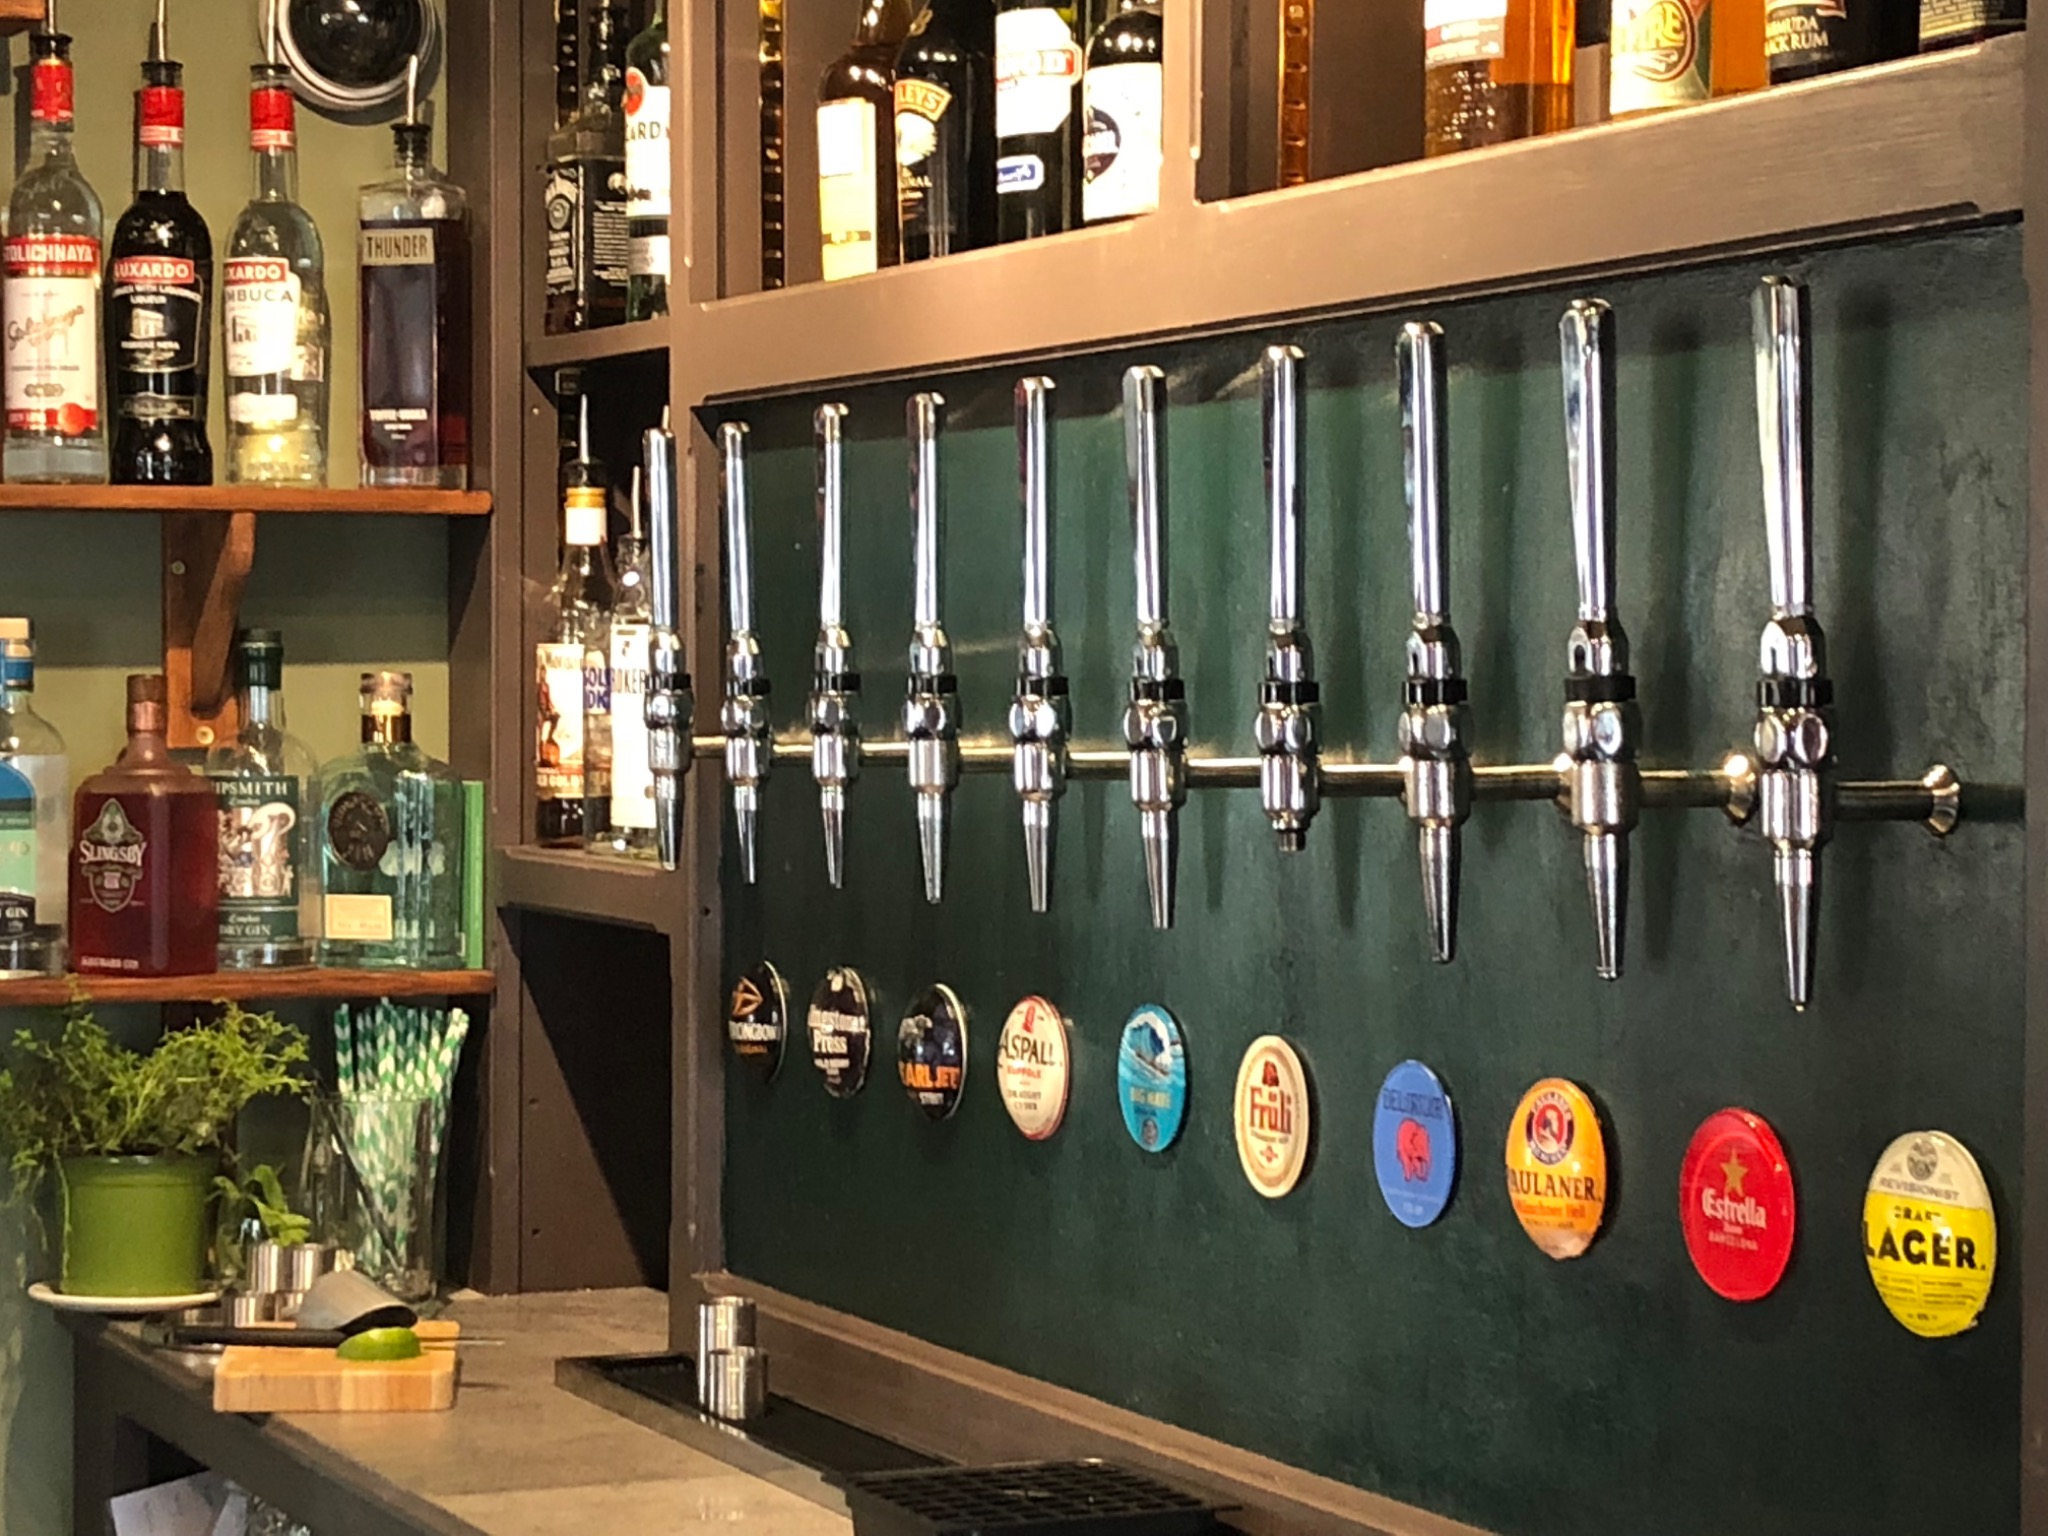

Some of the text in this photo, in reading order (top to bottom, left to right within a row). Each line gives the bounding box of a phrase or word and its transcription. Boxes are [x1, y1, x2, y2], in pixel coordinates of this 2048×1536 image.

[1791, 31, 1829, 50] RUM
[366, 235, 427, 258] THUNDER
[79, 840, 146, 867] SLINGSBY
[1880, 1177, 1960, 1201] REVISIONIST
[1702, 1187, 1766, 1230] Estrella
